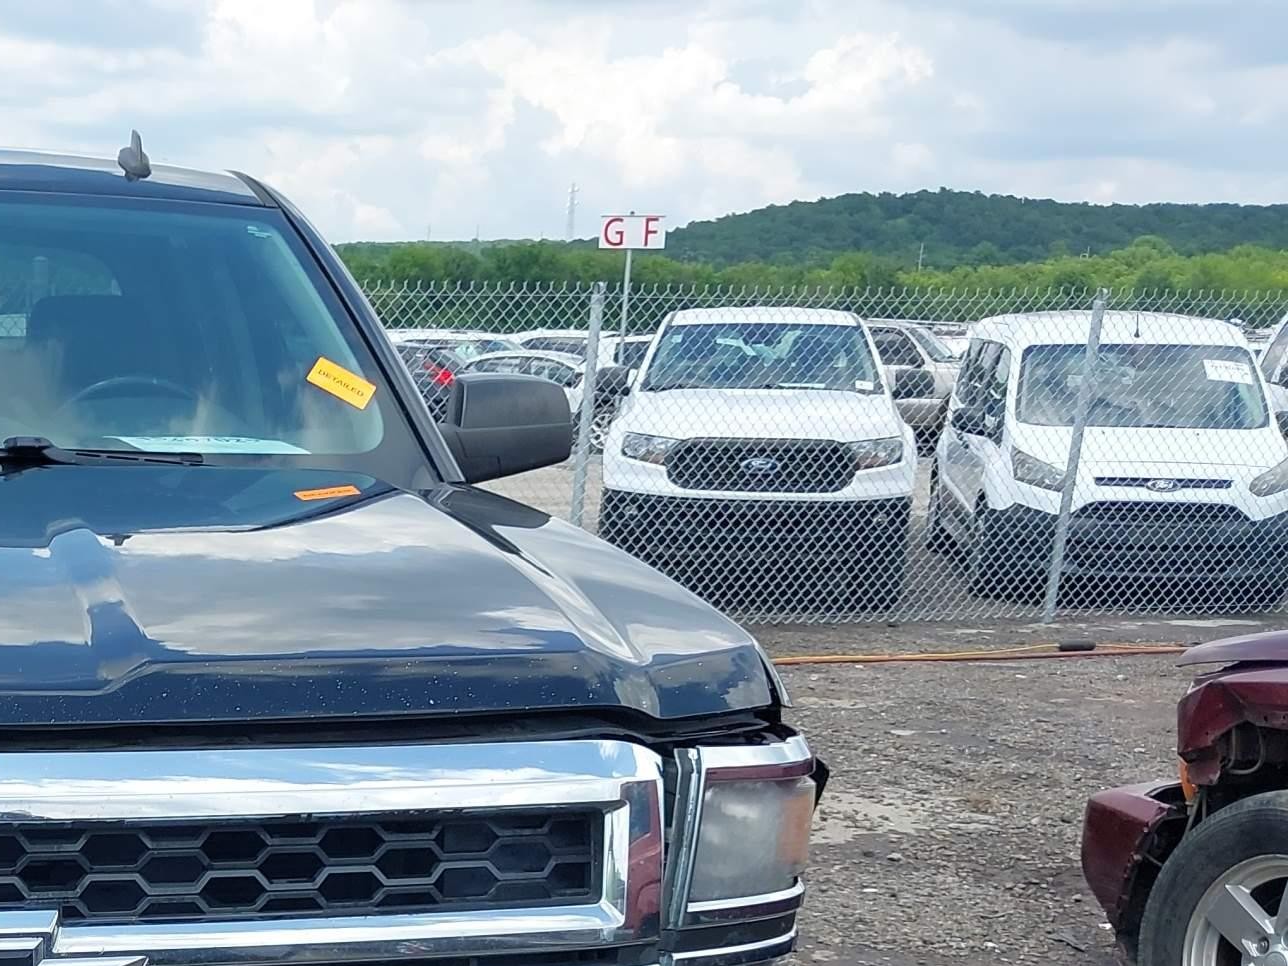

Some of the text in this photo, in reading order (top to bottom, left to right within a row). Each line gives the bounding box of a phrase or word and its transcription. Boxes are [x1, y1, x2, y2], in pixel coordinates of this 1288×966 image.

[604, 217, 660, 247] G F
[317, 368, 365, 398] DETAILED
